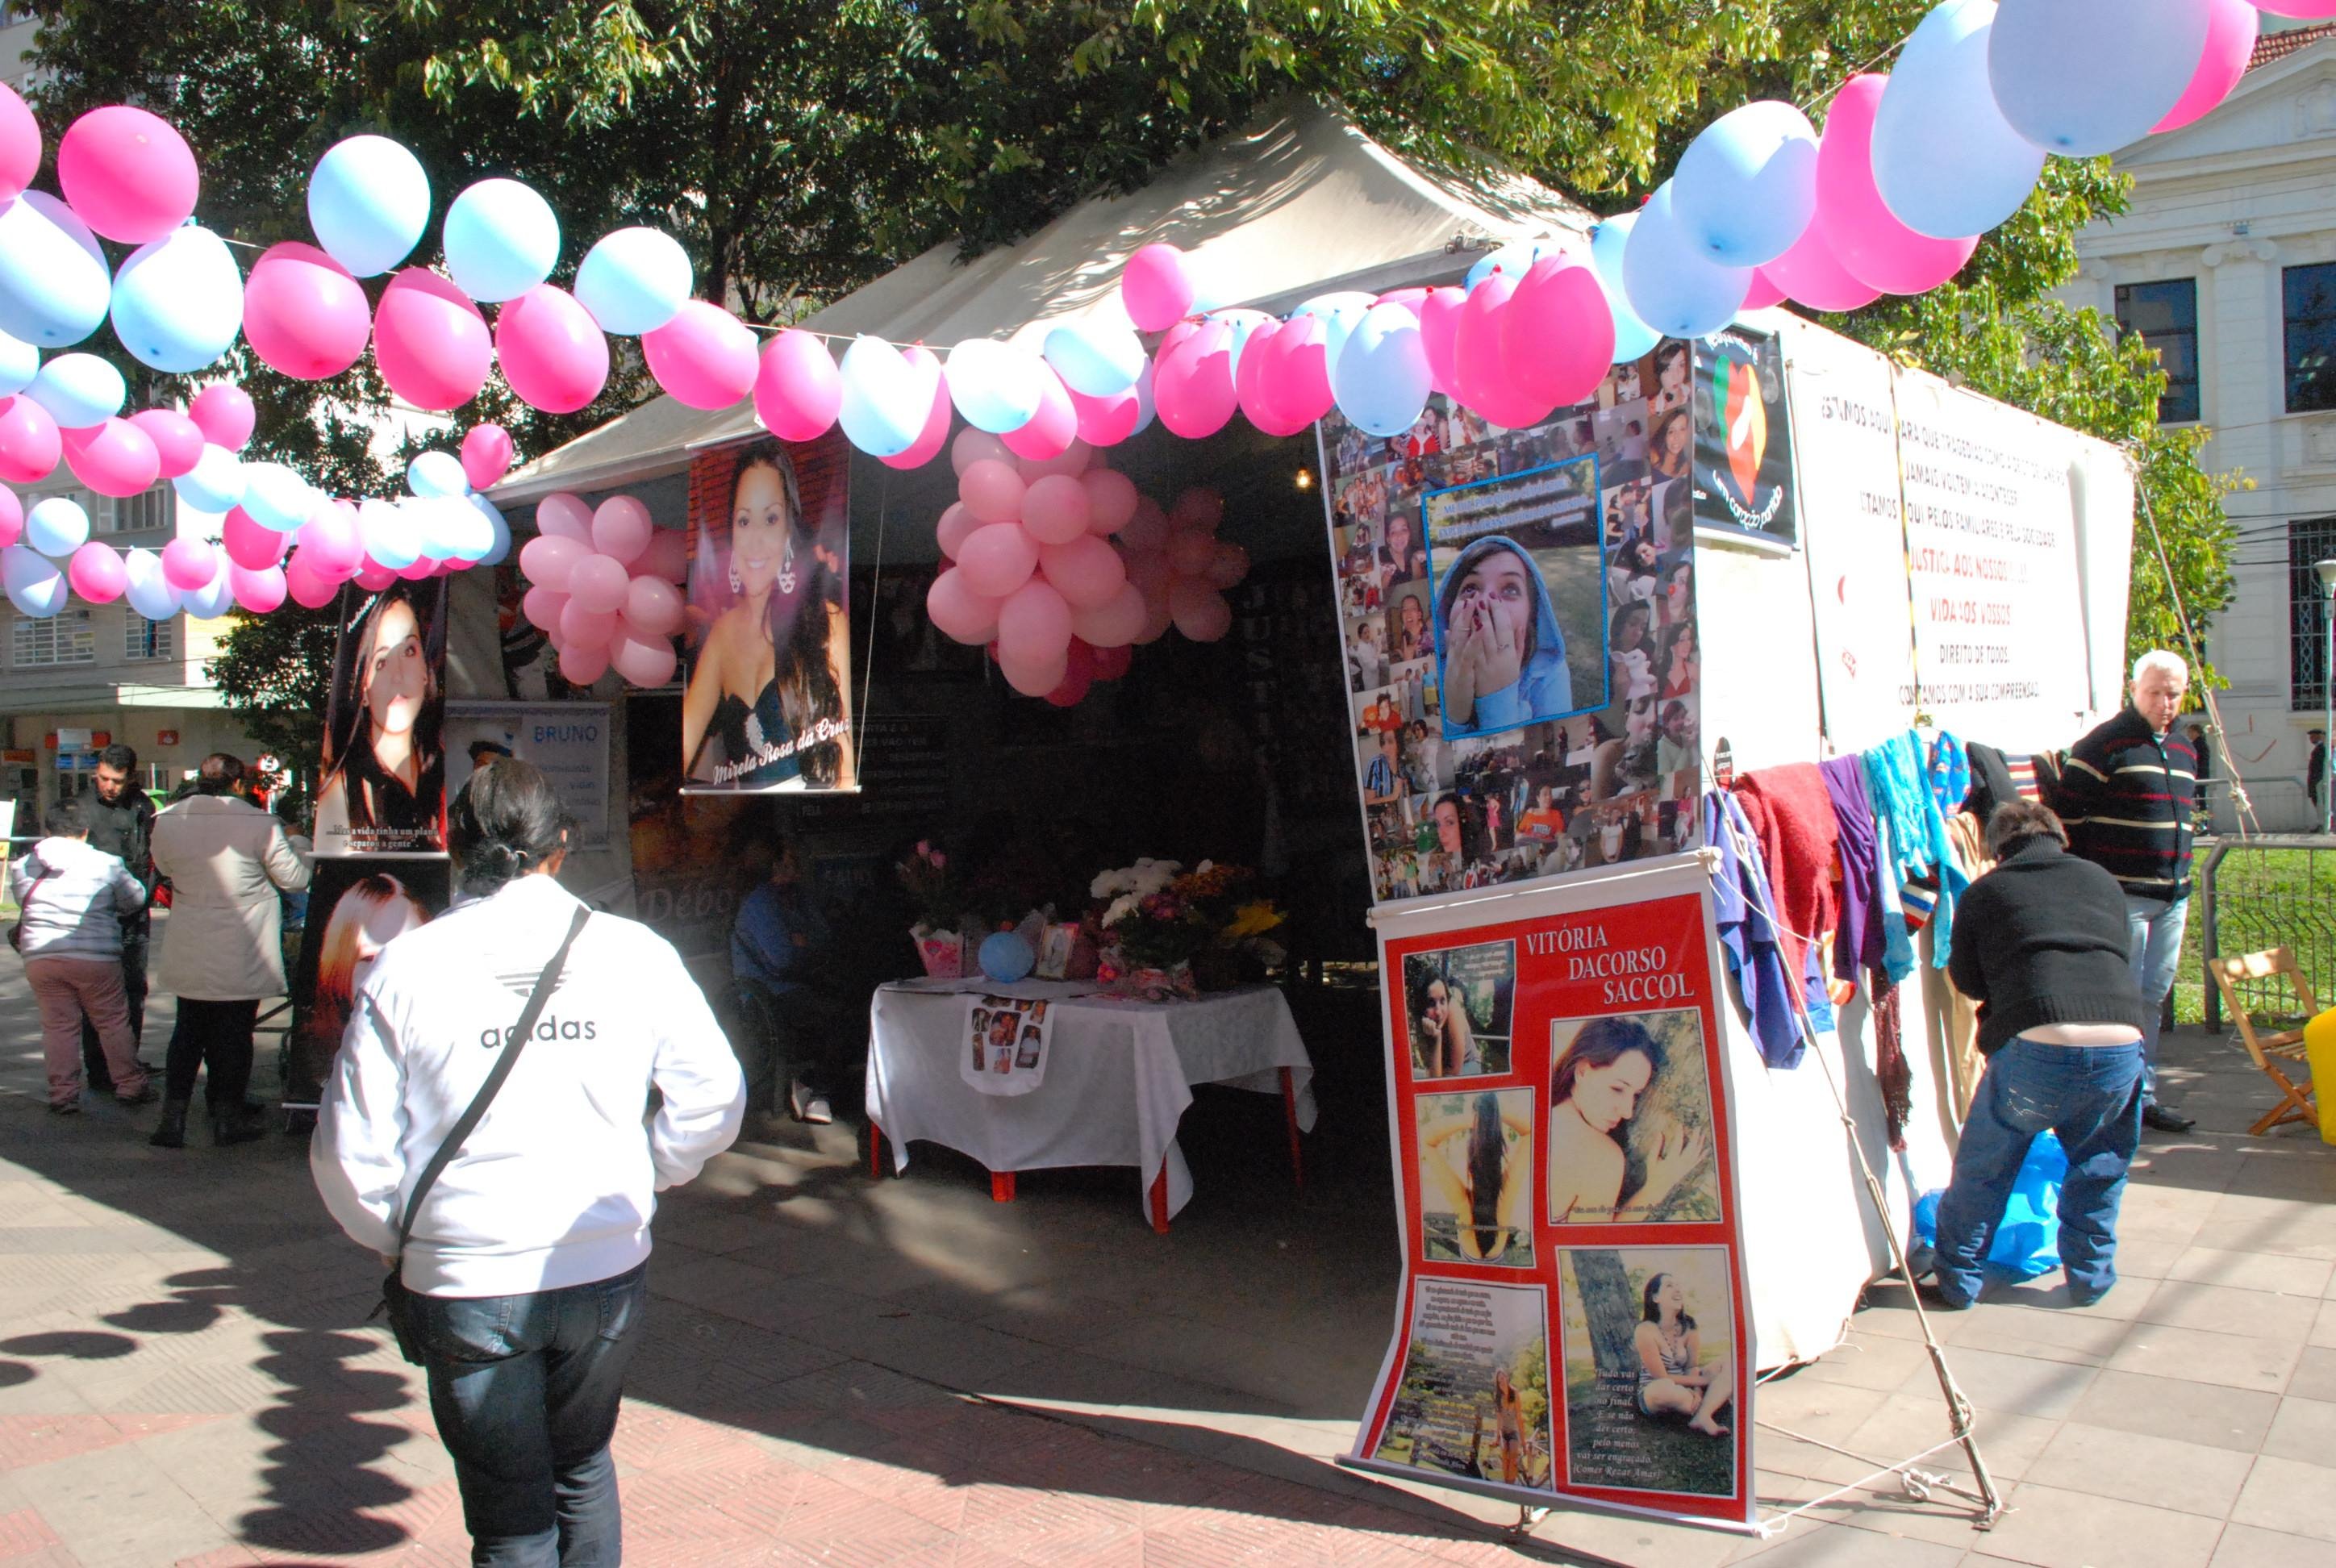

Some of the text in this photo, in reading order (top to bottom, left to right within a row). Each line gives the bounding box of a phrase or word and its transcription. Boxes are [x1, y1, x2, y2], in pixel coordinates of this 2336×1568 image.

[1870, 409, 1892, 435] AQUI
[1922, 426, 1940, 450] QUE
[1905, 461, 1939, 488] JAMAIS
[1941, 470, 1971, 496] VOLTEM
[1905, 501, 1925, 524] QUI
[1927, 506, 1954, 530] PELOS
[1955, 511, 1998, 539] FAMILIARES
[1953, 552, 1974, 578] AOS
[1975, 556, 2008, 582] NOSSOS
[1930, 597, 1957, 623] VIDA
[1939, 644, 1973, 664] DIREITO
[1975, 644, 1984, 664] DE
[1949, 682, 1966, 703] COM
[1975, 682, 1989, 703] SUA
[534, 725, 599, 744] BRUNO
[713, 717, 851, 787] Mirela Rosa da Cruz
[357, 826, 374, 835] vida
[376, 825, 398, 835] tinha
[415, 826, 439, 837] plano
[639, 878, 733, 922] Débo
[1526, 924, 1609, 956] VITÓRIA
[1569, 946, 1667, 981] DACORSO
[1603, 973, 1696, 1005] SACCOL
[480, 1015, 597, 1049] adas
[1621, 1370, 1635, 1378] vai
[1596, 1383, 1610, 1391] dar
[1608, 1396, 1633, 1408] final.
[1618, 1412, 1634, 1420] não
[1596, 1425, 1610, 1433] der
[1592, 1438, 1640, 1449] pelo menos
[1577, 1451, 1591, 1460] vai
[1592, 1453, 1605, 1461] ser
[1605, 1466, 1632, 1476] Rezar
